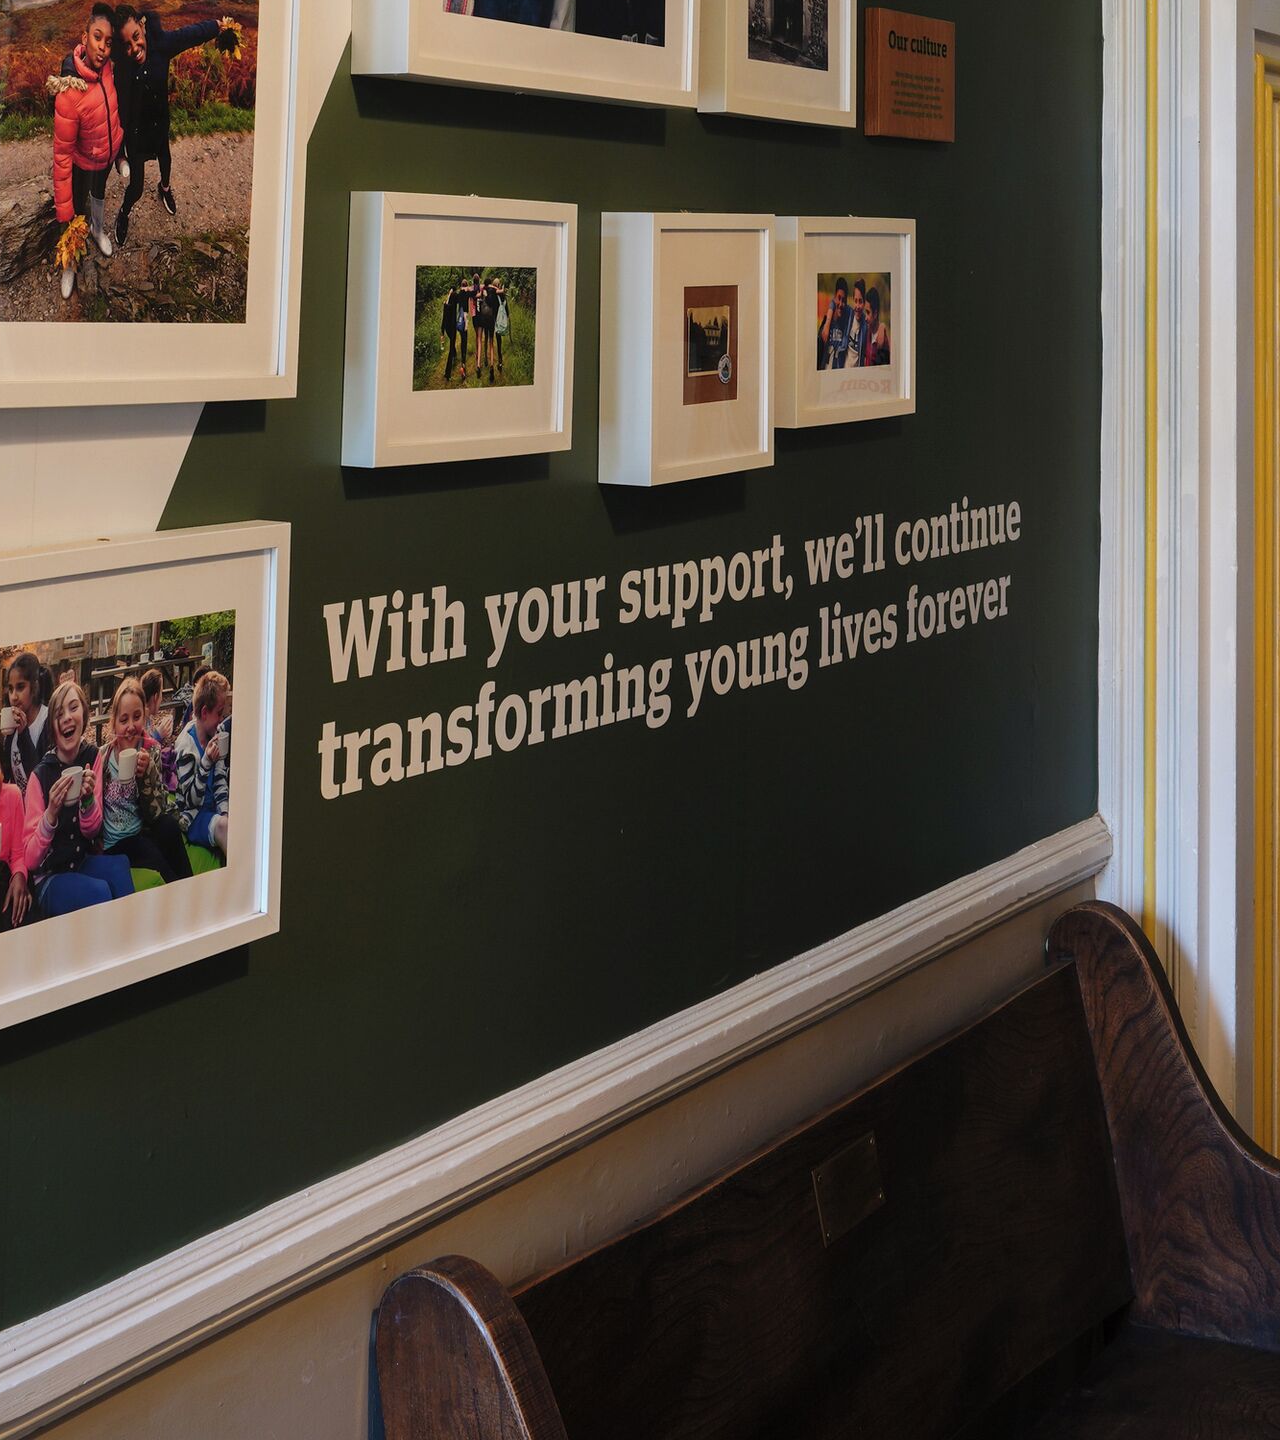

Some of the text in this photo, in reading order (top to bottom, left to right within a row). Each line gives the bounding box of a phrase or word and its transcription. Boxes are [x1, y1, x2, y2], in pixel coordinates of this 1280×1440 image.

[889, 31, 948, 58] Our culture
[324, 585, 467, 683] With
[484, 573, 606, 668] your
[620, 534, 794, 629] support,
[894, 495, 1021, 563] continue
[318, 574, 1012, 800] transforming young lives forever
